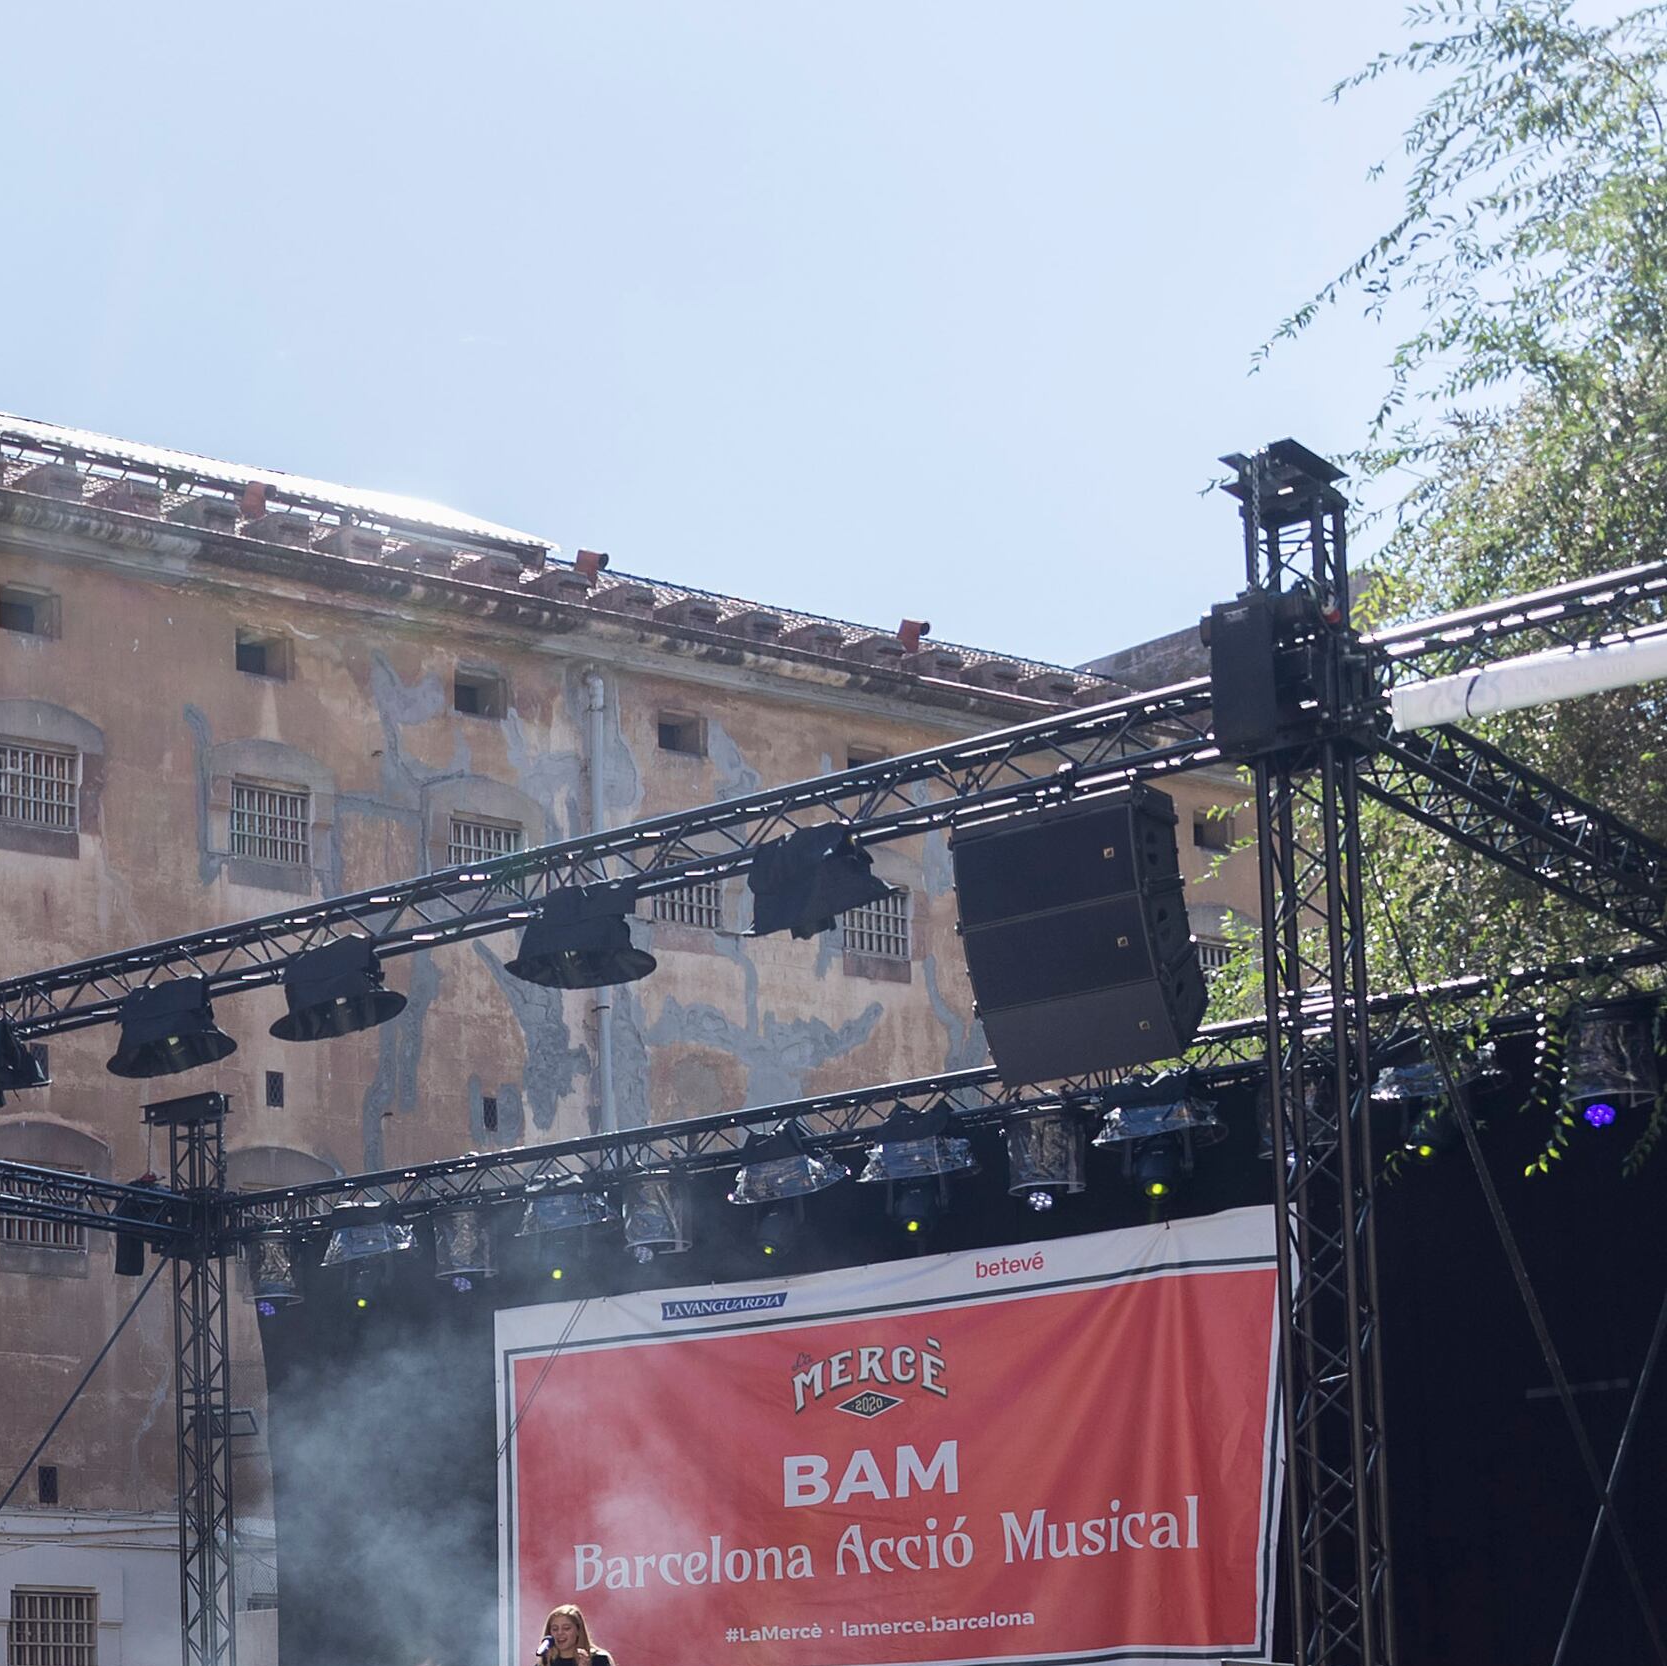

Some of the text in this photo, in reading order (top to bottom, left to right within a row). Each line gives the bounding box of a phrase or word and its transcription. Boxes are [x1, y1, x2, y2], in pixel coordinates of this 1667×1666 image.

[975, 1250, 1044, 1279] betevé
[792, 1336, 948, 1415] MERCÈ
[854, 1395, 884, 1412] 2020
[782, 1439, 960, 1509] BAM
[572, 1494, 1201, 1593] Barcelona Acció Musical
[724, 1610, 1036, 1644] #LaMercè lamerce.barcelona
